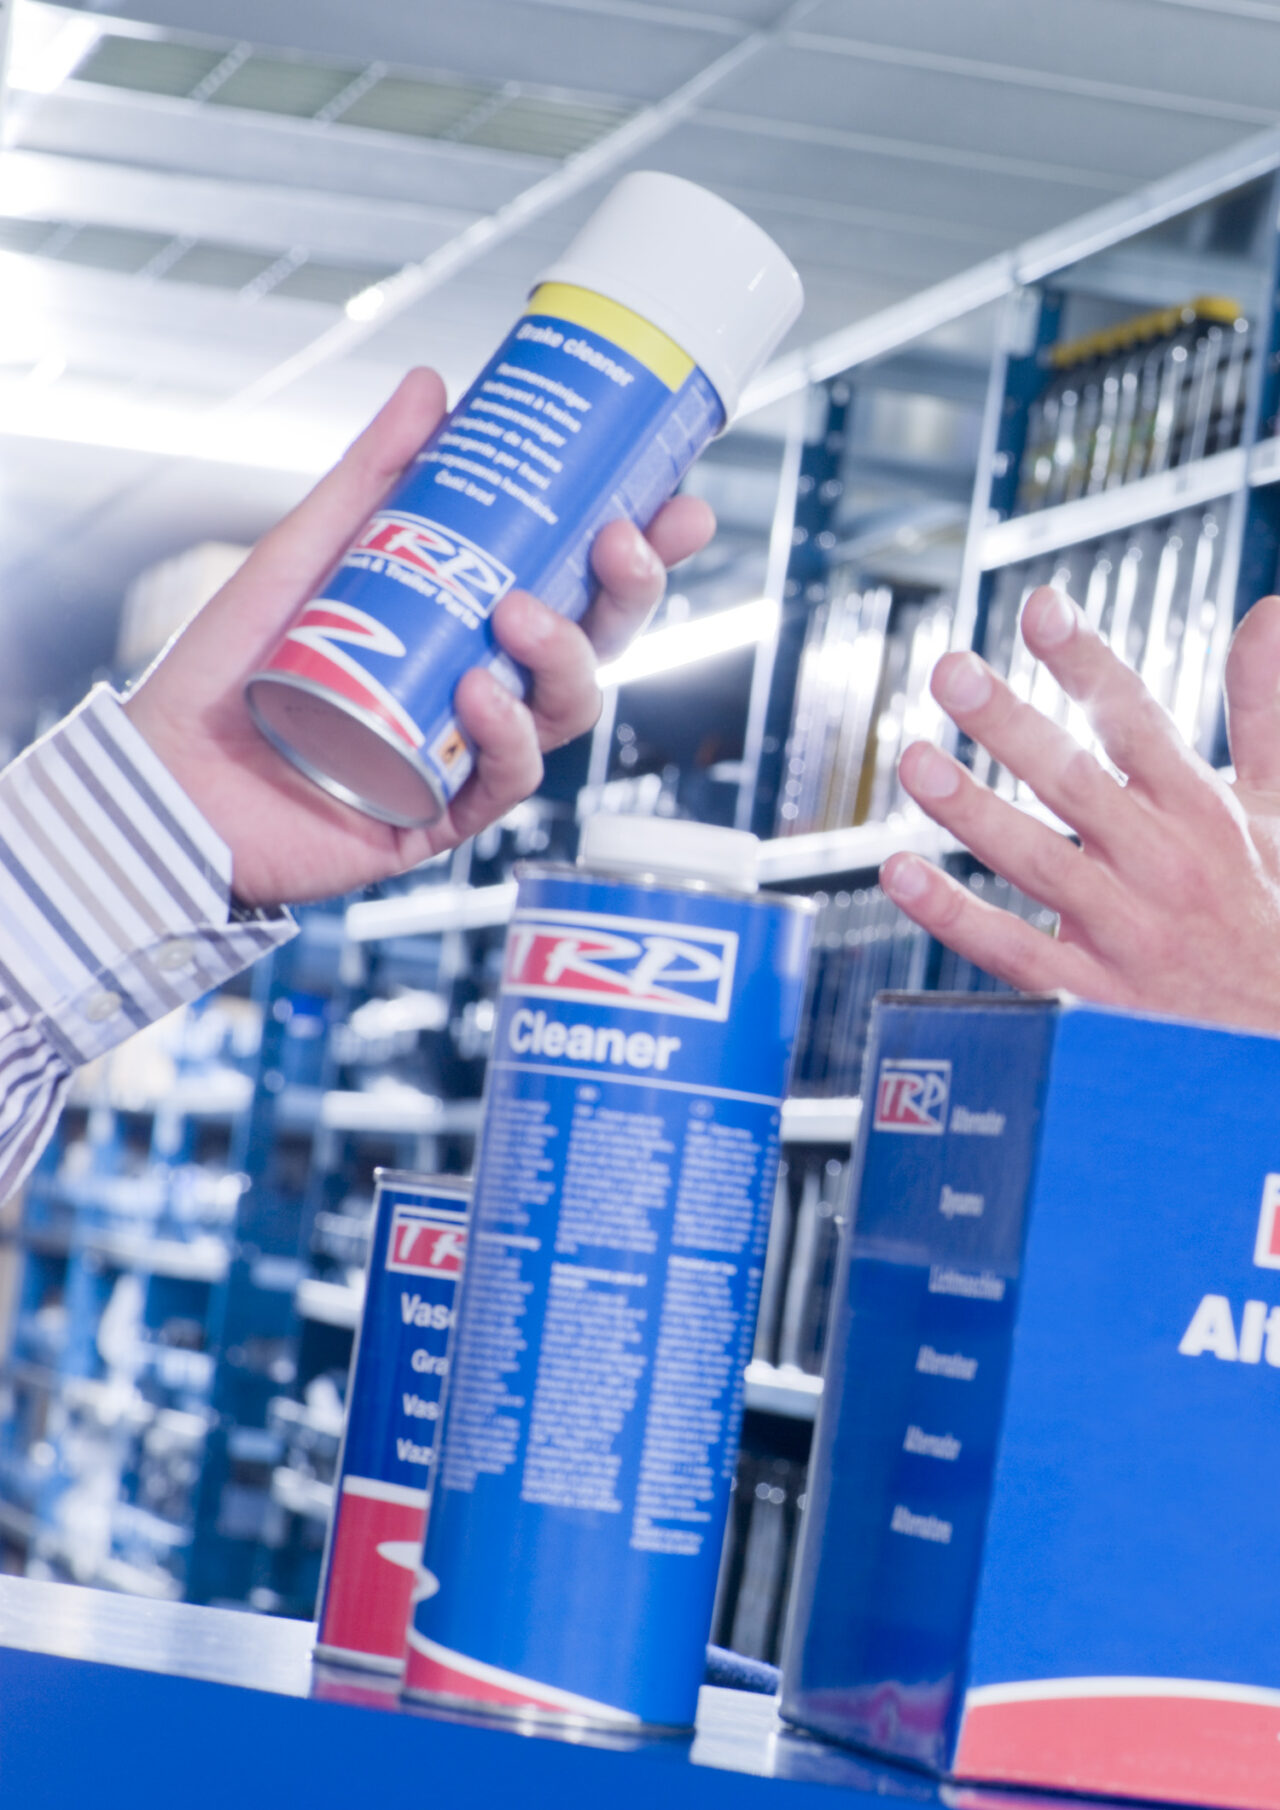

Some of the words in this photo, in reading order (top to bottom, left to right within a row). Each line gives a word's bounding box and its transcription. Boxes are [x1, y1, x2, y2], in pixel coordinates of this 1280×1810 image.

[517, 322, 564, 349] Brake
[562, 338, 635, 388] cleaner
[360, 519, 501, 614] TRP
[385, 560, 439, 598] Trailer
[435, 589, 481, 631] Parts
[504, 922, 728, 1016] TRP
[507, 1008, 682, 1071] Cleaner
[880, 1071, 949, 1130] TRP
[411, 1348, 450, 1376] Gra
[402, 1392, 441, 1421] Vas
[396, 1437, 437, 1466] Vaz
